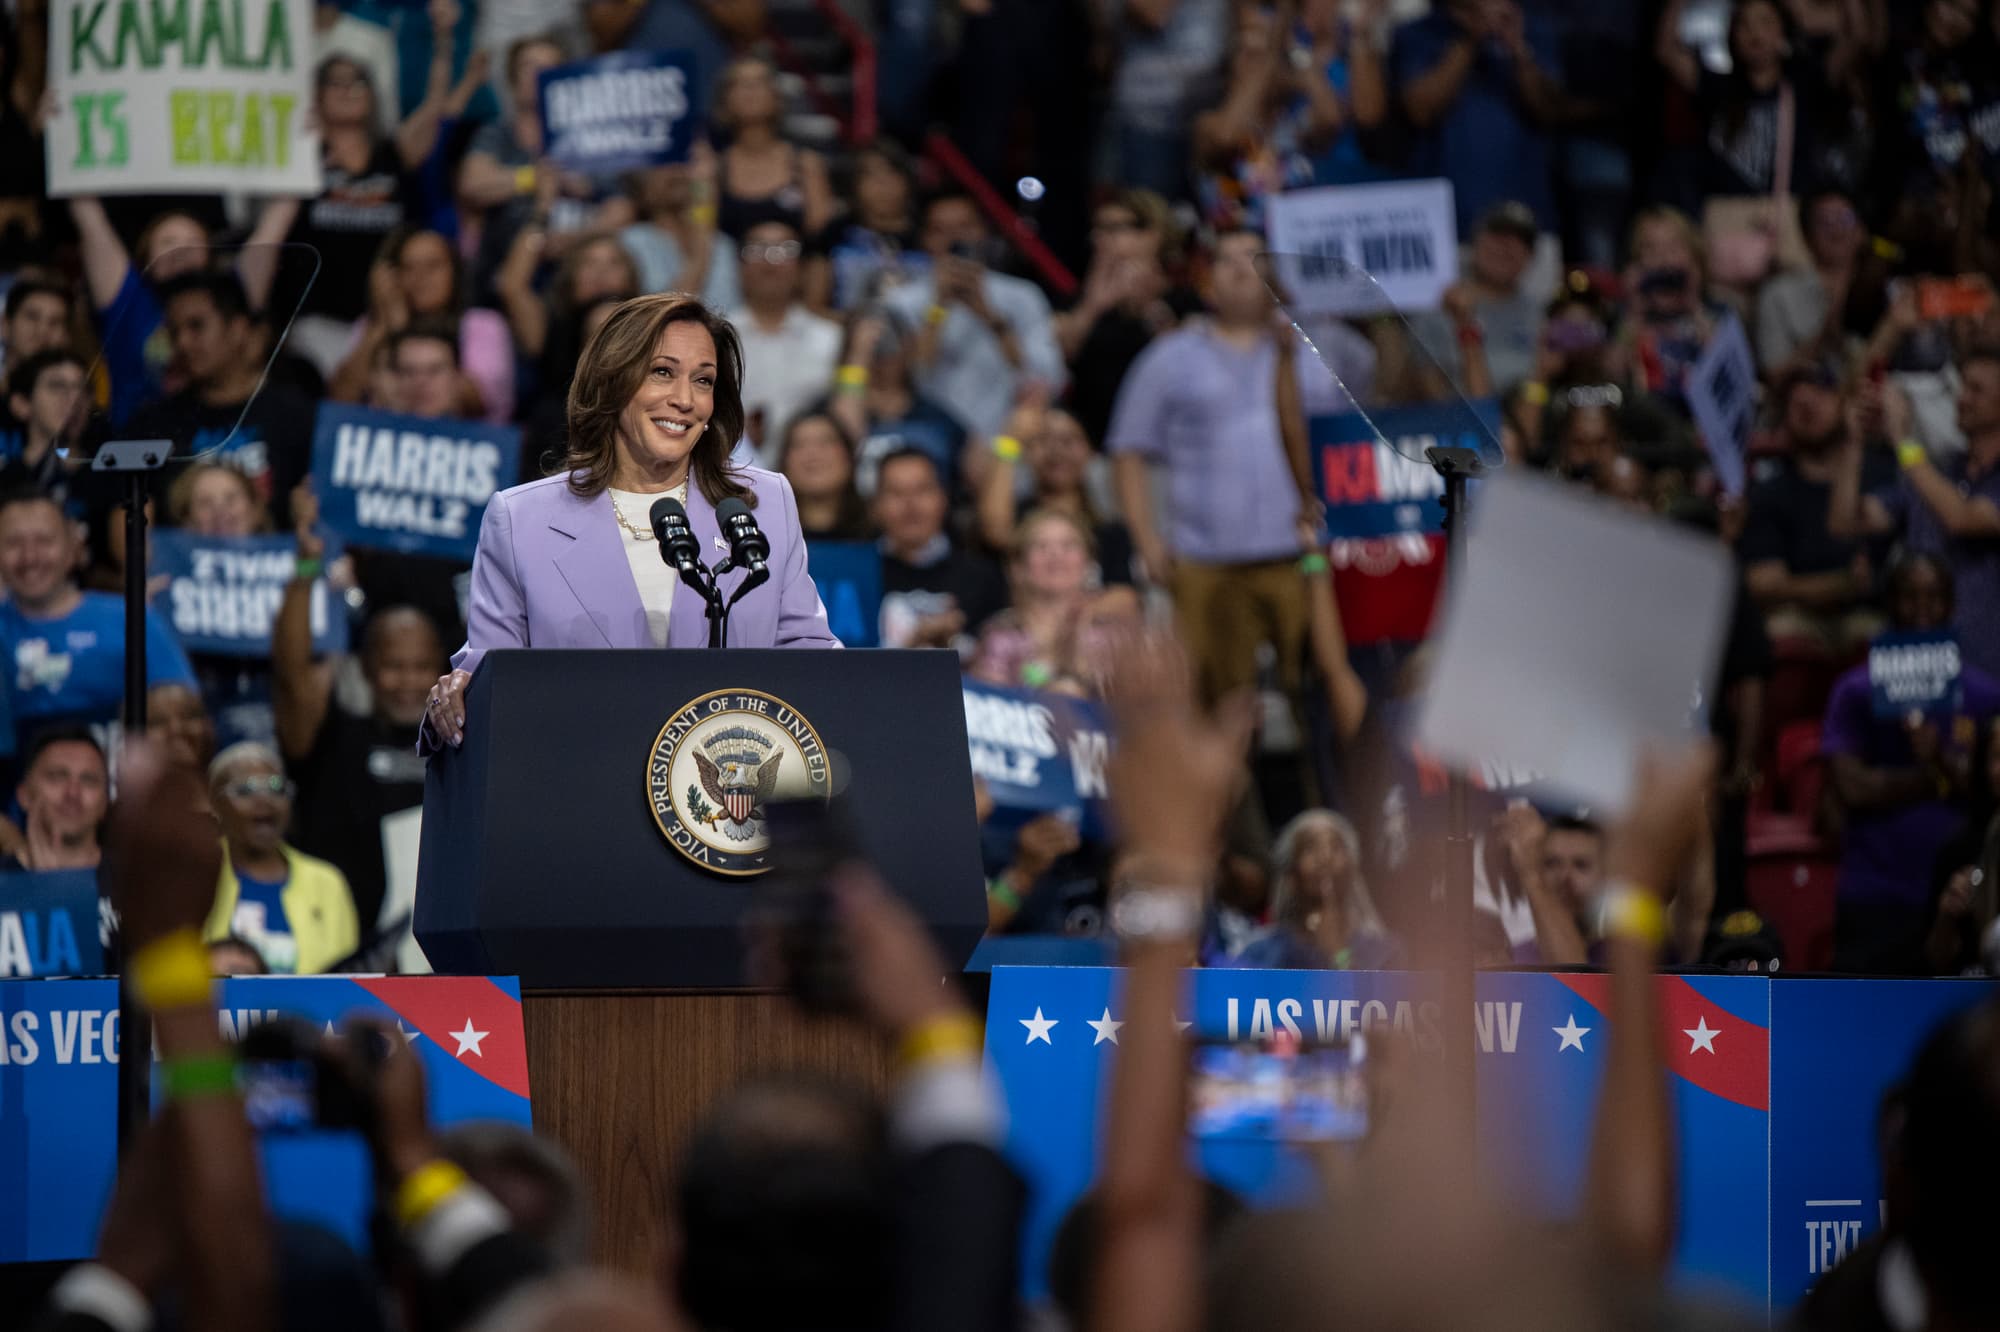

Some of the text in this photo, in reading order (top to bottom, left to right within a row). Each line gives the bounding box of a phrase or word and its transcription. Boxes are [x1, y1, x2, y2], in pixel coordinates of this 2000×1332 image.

[68, 0, 293, 75] KAMALA
[71, 87, 298, 172] IS BRAT
[545, 66, 689, 131] HARRIS
[331, 423, 501, 506] HARRIS
[354, 488, 469, 540] WALZ
[1868, 641, 1962, 688] HARRIS
[651, 696, 827, 864] VICE PRESIDENT OF THE UNITED
[1227, 997, 1304, 1044] LAS
[1474, 1002, 1523, 1053] NV
[1805, 1220, 1862, 1274] TEXT
